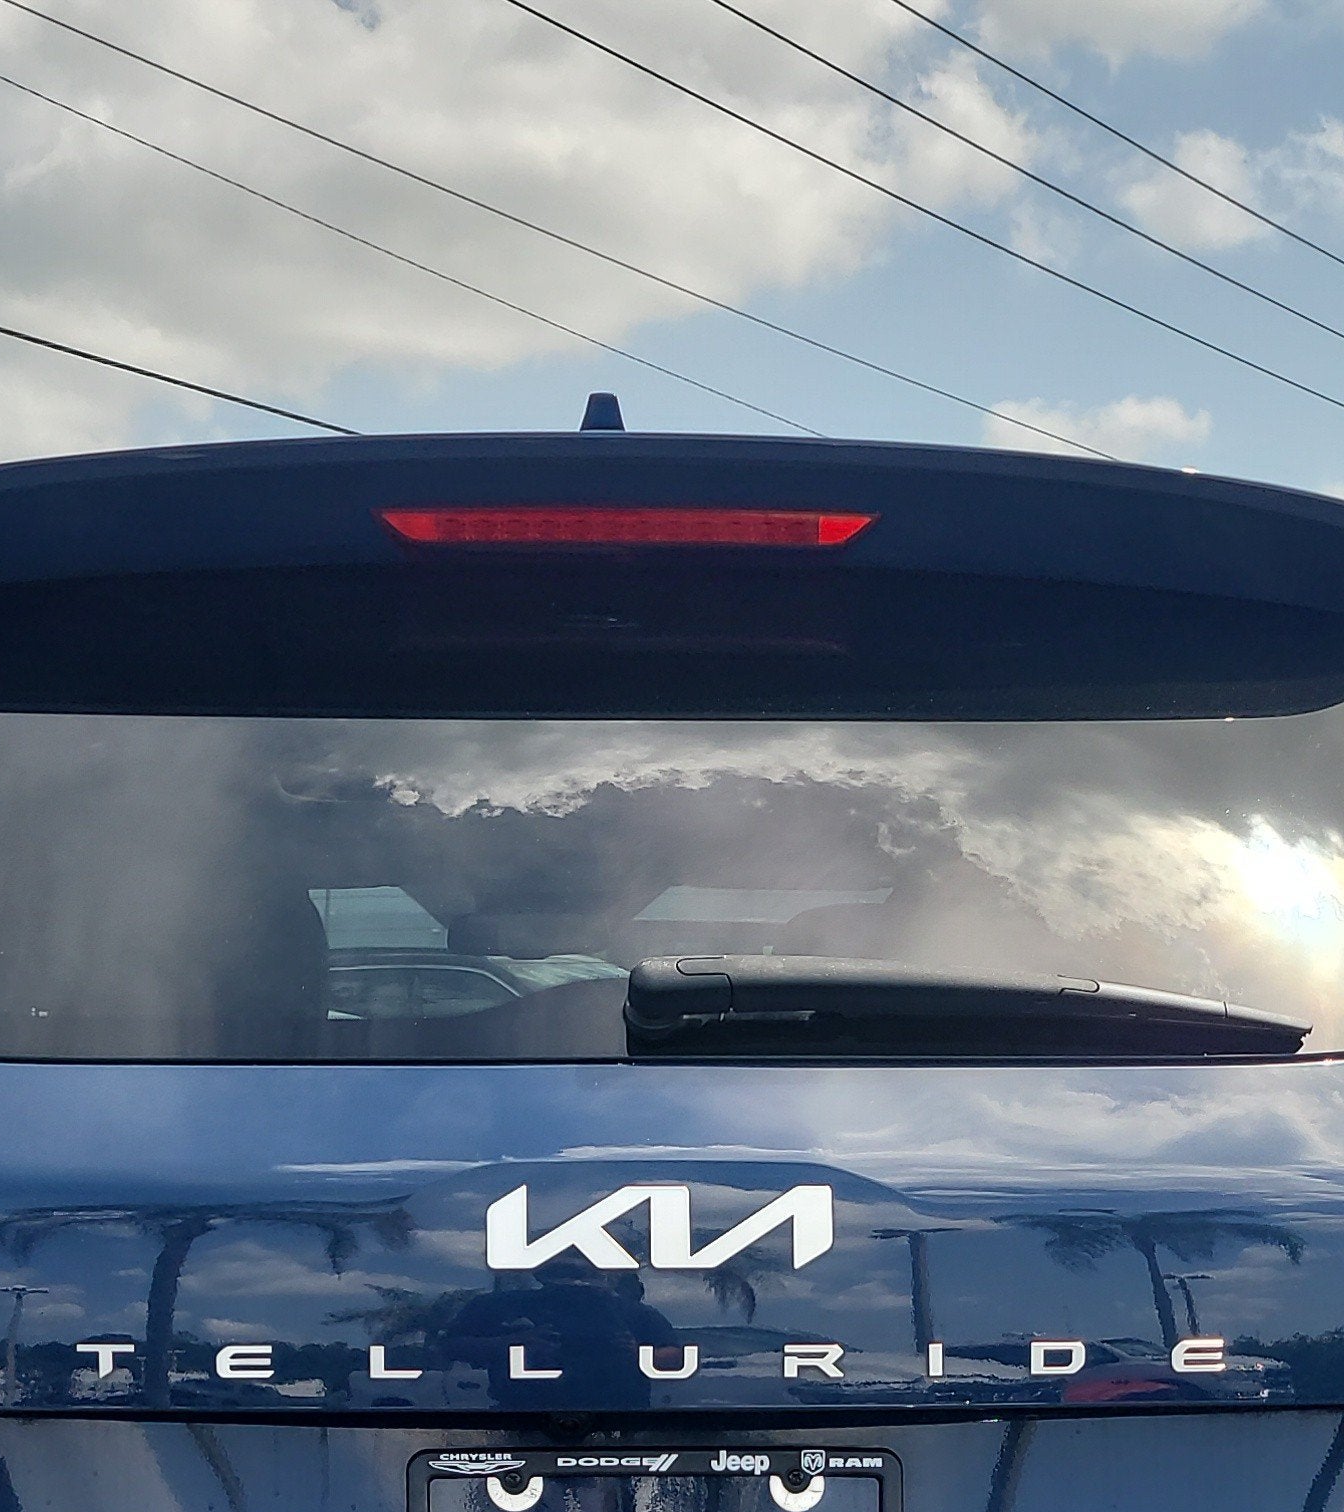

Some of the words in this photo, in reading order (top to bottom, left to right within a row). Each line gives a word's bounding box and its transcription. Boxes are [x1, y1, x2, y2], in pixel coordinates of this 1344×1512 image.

[485, 1183, 834, 1271] KIA
[76, 1336, 1227, 1380] TELLURIDE
[439, 1452, 513, 1461] CHRYSLER
[556, 1457, 660, 1467] DODGE
[710, 1449, 771, 1476] Jeep
[828, 1457, 884, 1468] RAM
